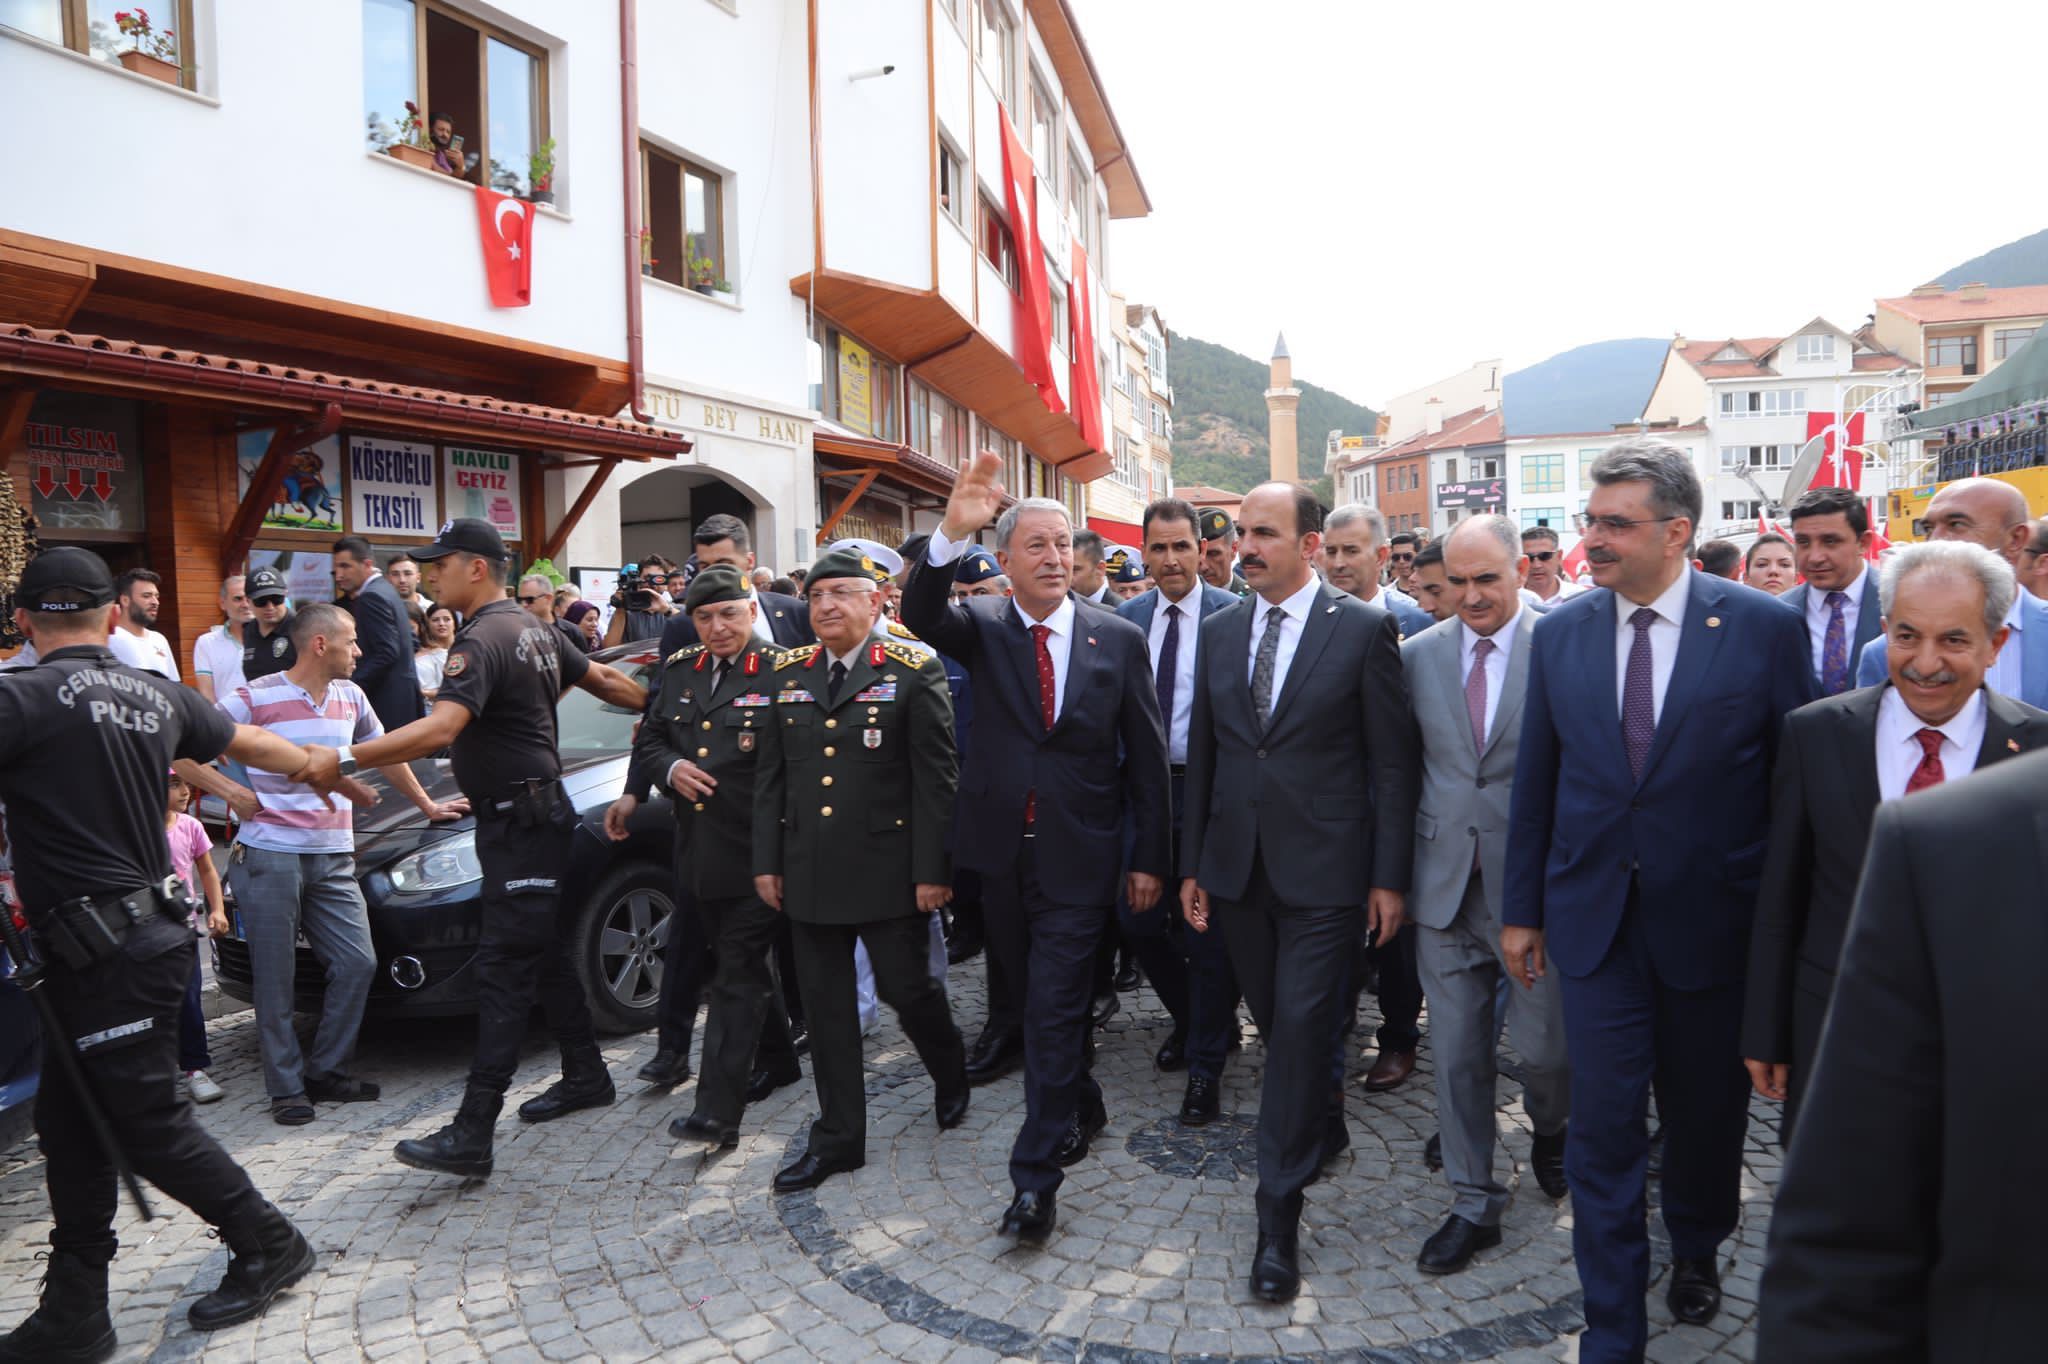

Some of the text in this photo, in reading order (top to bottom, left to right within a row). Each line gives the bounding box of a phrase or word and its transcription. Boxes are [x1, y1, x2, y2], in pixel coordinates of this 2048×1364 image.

[642, 390, 804, 444] TÜ BEY HANI
[25, 422, 118, 453] TILSIM
[352, 441, 432, 486] KÖSEOĞLU
[452, 450, 510, 470] HAVLU
[456, 470, 507, 491] ÇEYİZ
[363, 491, 424, 530] TEKSTİL
[107, 671, 175, 720] KUVVET
